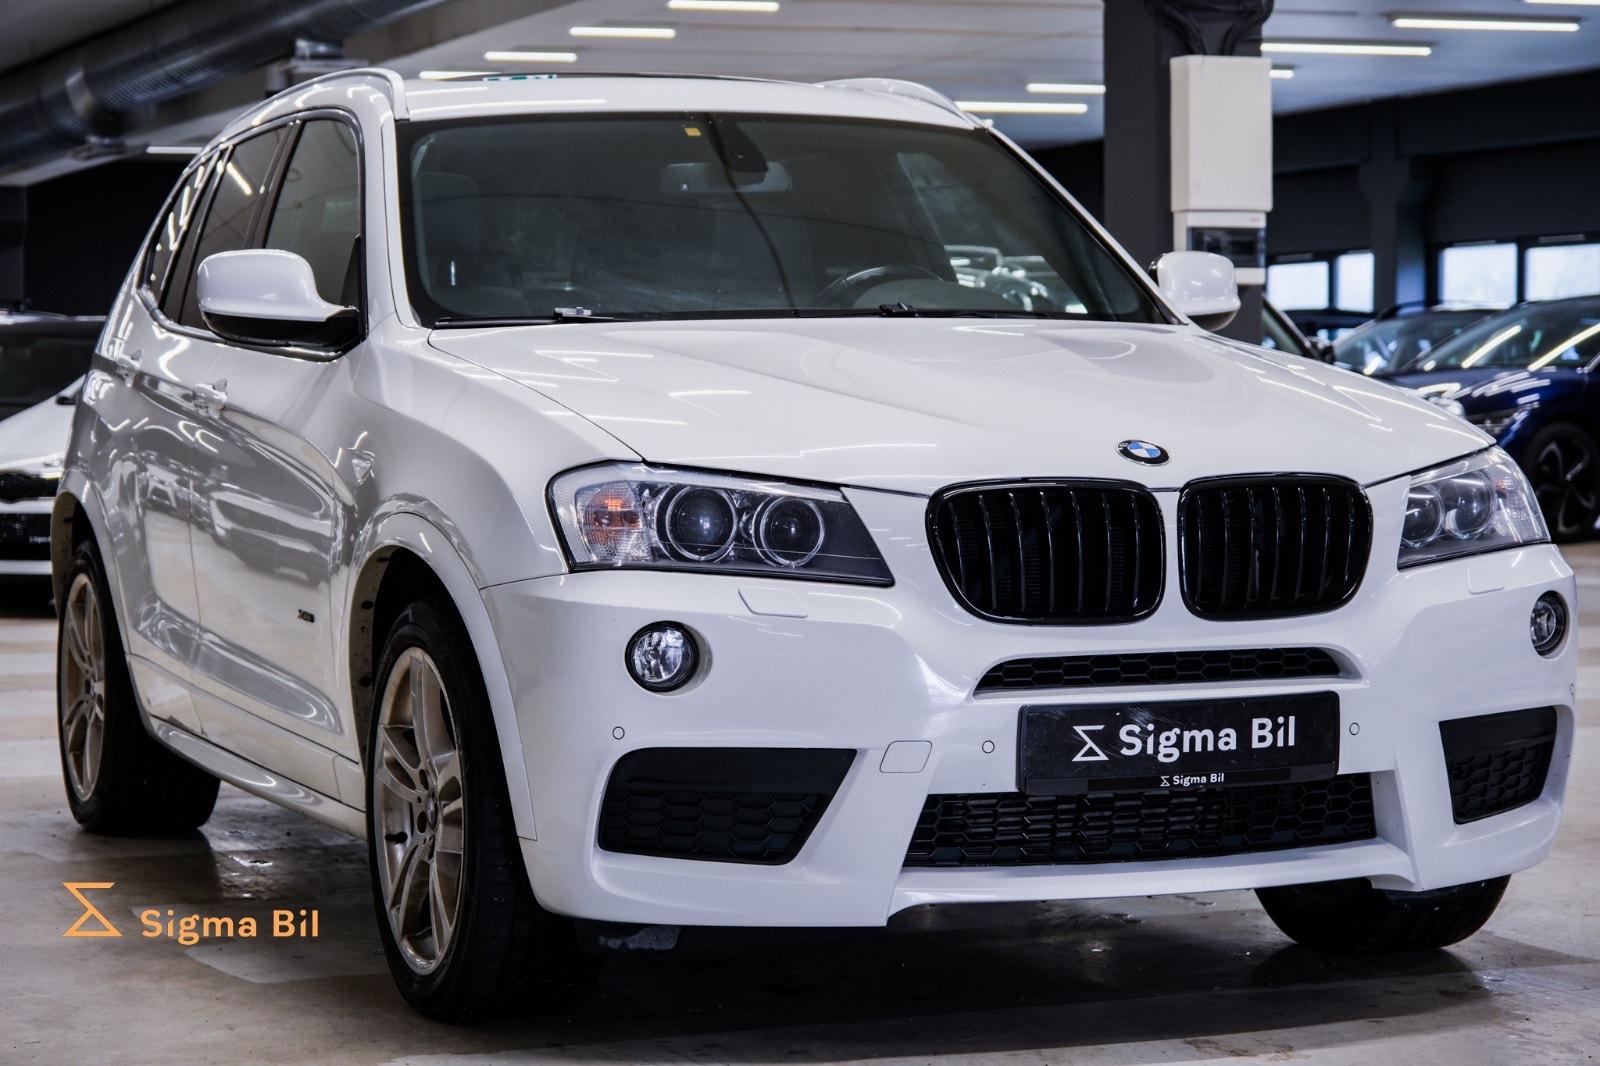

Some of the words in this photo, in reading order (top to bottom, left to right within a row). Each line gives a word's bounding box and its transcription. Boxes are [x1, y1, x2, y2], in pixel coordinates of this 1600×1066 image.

[1118, 723, 1238, 763] Sigma
[1250, 715, 1296, 749] Bil
[1172, 774, 1207, 787] Sigma
[1210, 772, 1225, 783] Bil
